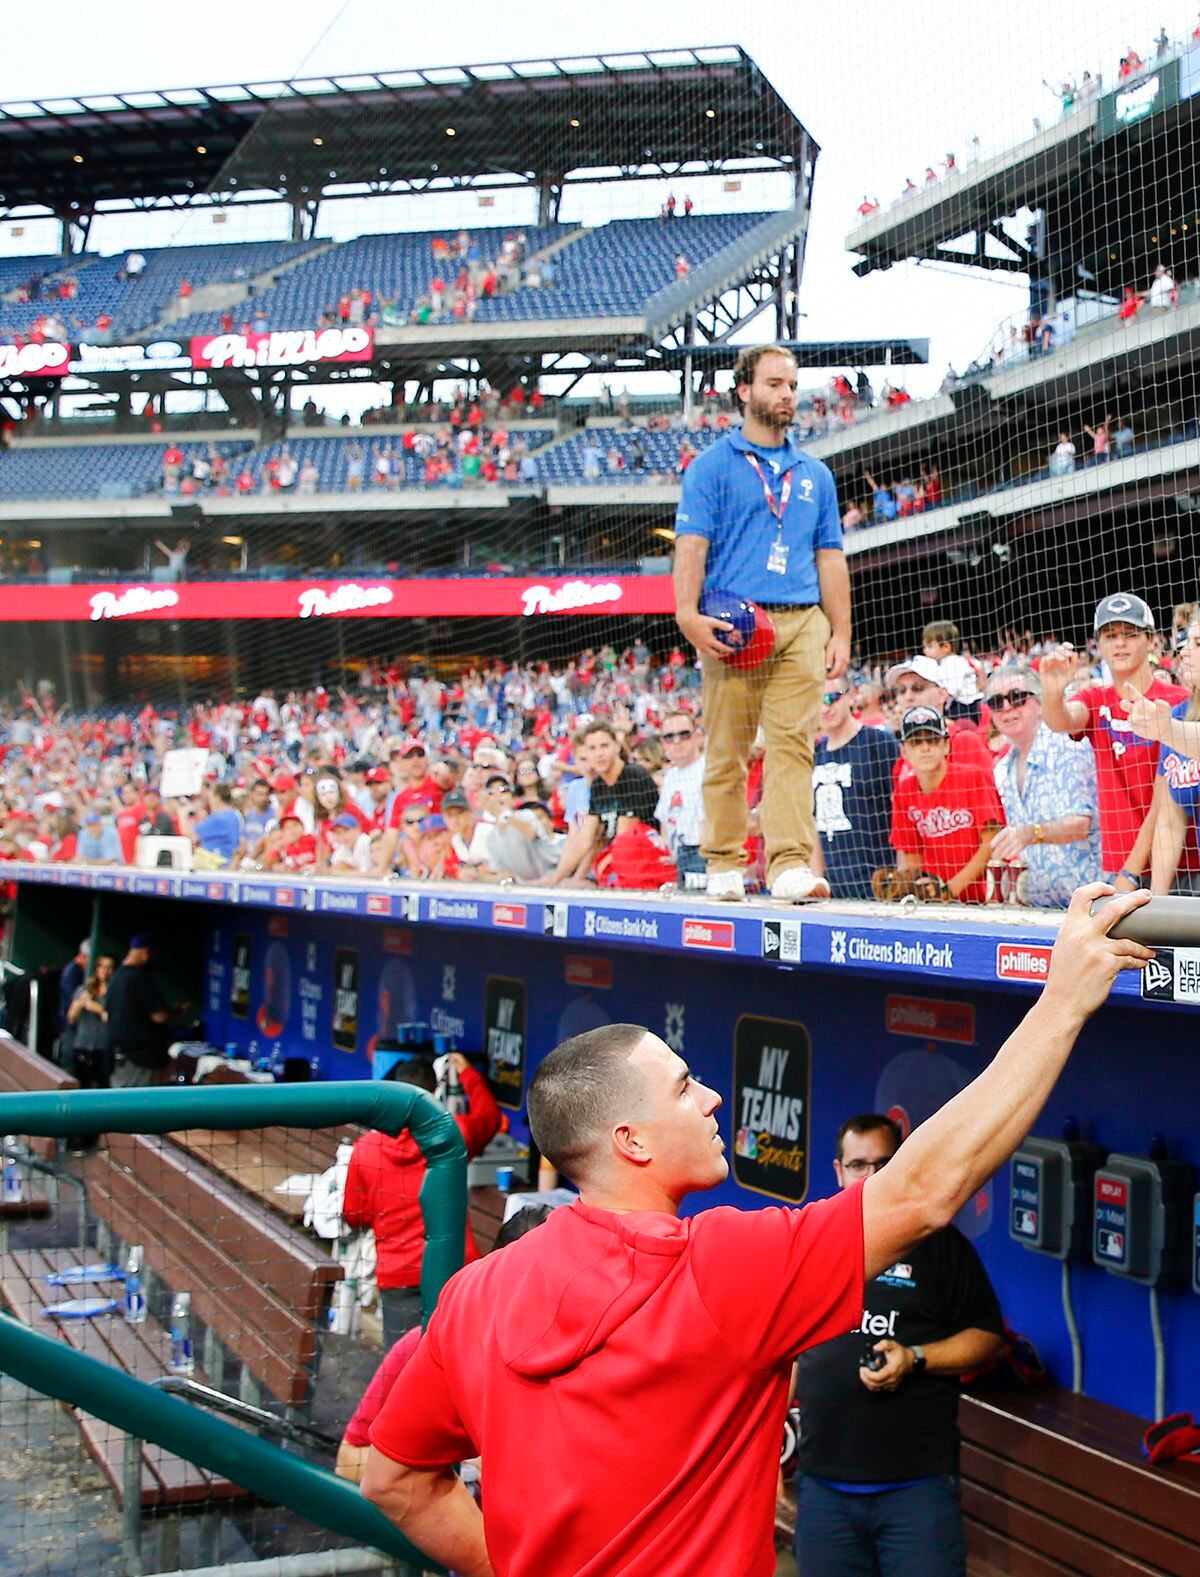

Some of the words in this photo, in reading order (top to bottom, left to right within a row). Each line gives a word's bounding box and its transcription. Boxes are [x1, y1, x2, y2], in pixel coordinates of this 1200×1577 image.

[595, 915, 625, 935] Citizens
[624, 918, 641, 937] Bank
[641, 919, 659, 938] Park
[849, 937, 893, 963] Citizens
[895, 942, 923, 966] Bank
[926, 944, 953, 968] Park
[758, 1046, 790, 1091] MY
[742, 1087, 803, 1142] TEAMS
[755, 1132, 804, 1173] Sports
